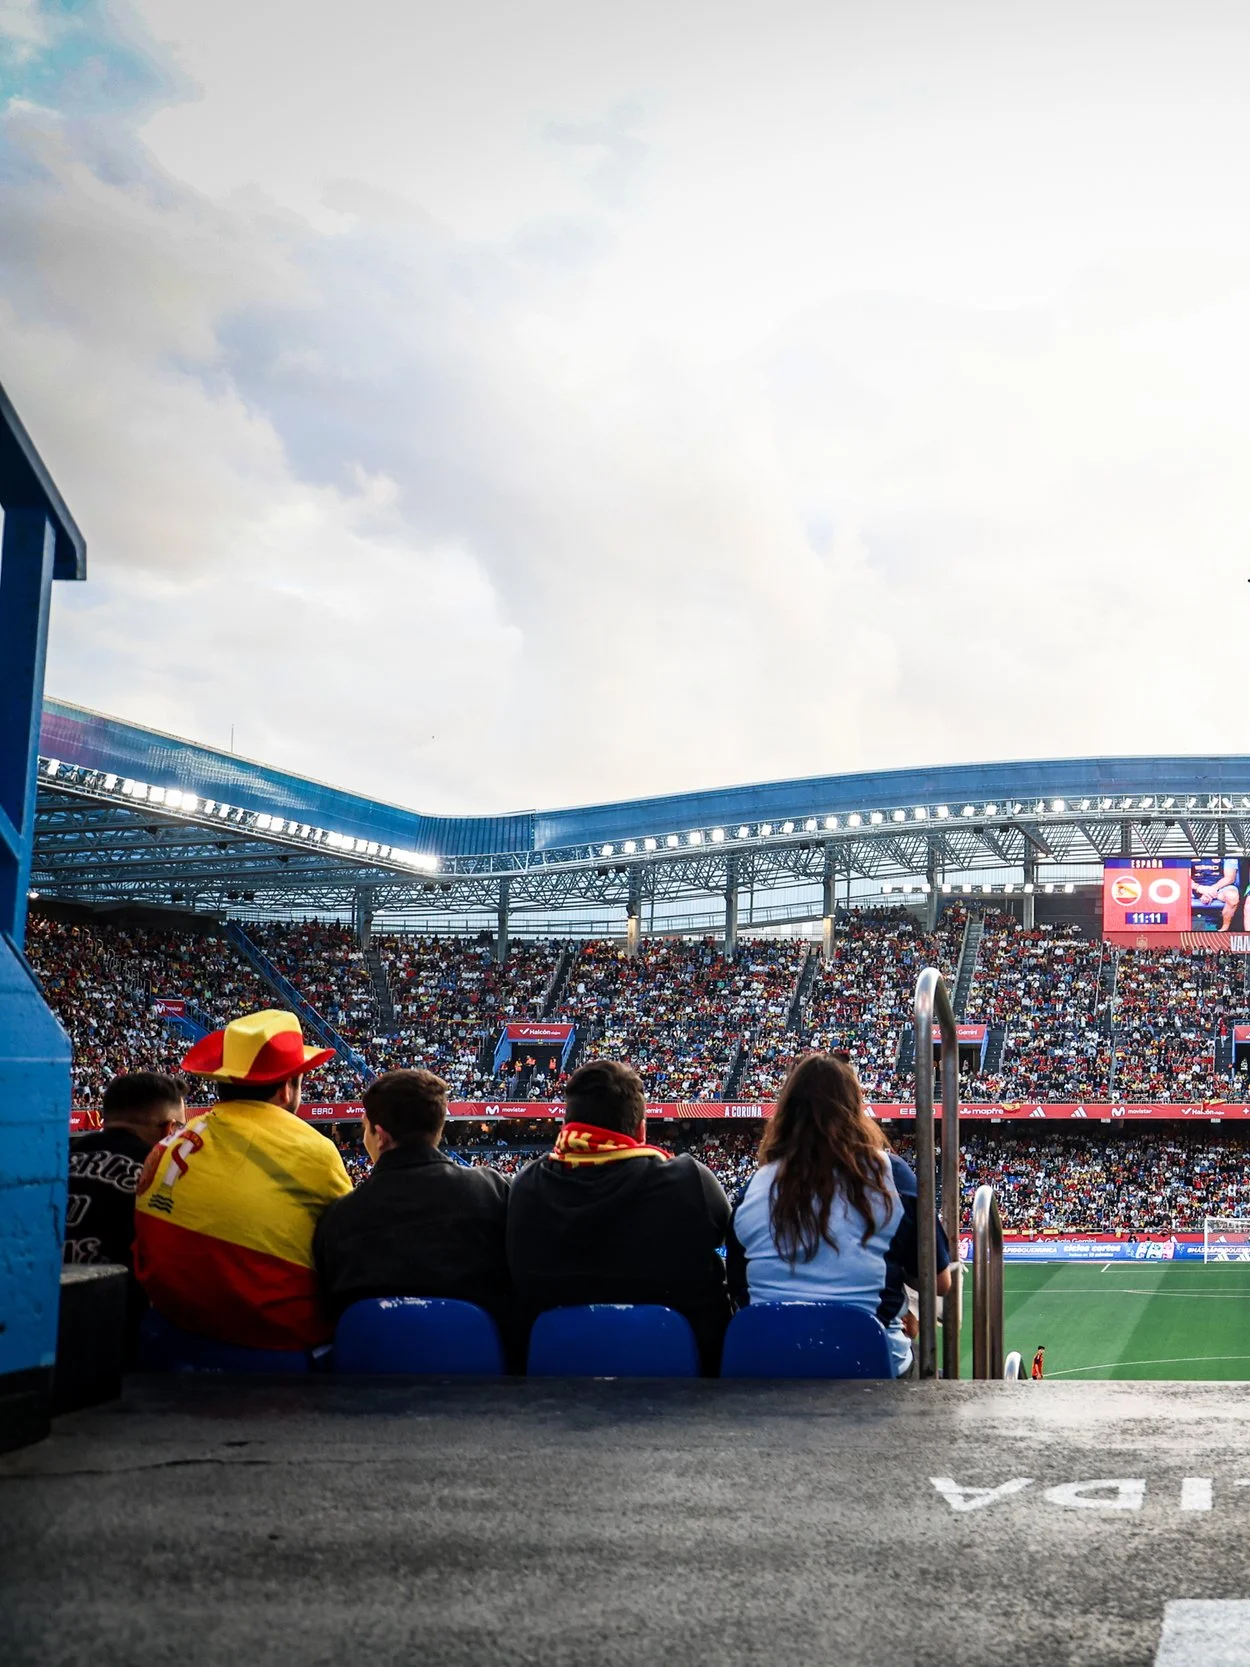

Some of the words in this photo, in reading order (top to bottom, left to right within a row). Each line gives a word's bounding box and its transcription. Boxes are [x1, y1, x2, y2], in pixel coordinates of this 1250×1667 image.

[1148, 878, 1181, 904] 0
[1132, 913, 1161, 924] 11:11
[311, 1107, 334, 1115] EBRO
[724, 1106, 731, 1117] A
[731, 1104, 763, 1117] CORUÑA
[972, 1107, 1004, 1116] mapfre
[1063, 1244, 1090, 1252] ciclos
[1091, 1244, 1121, 1252] cortos
